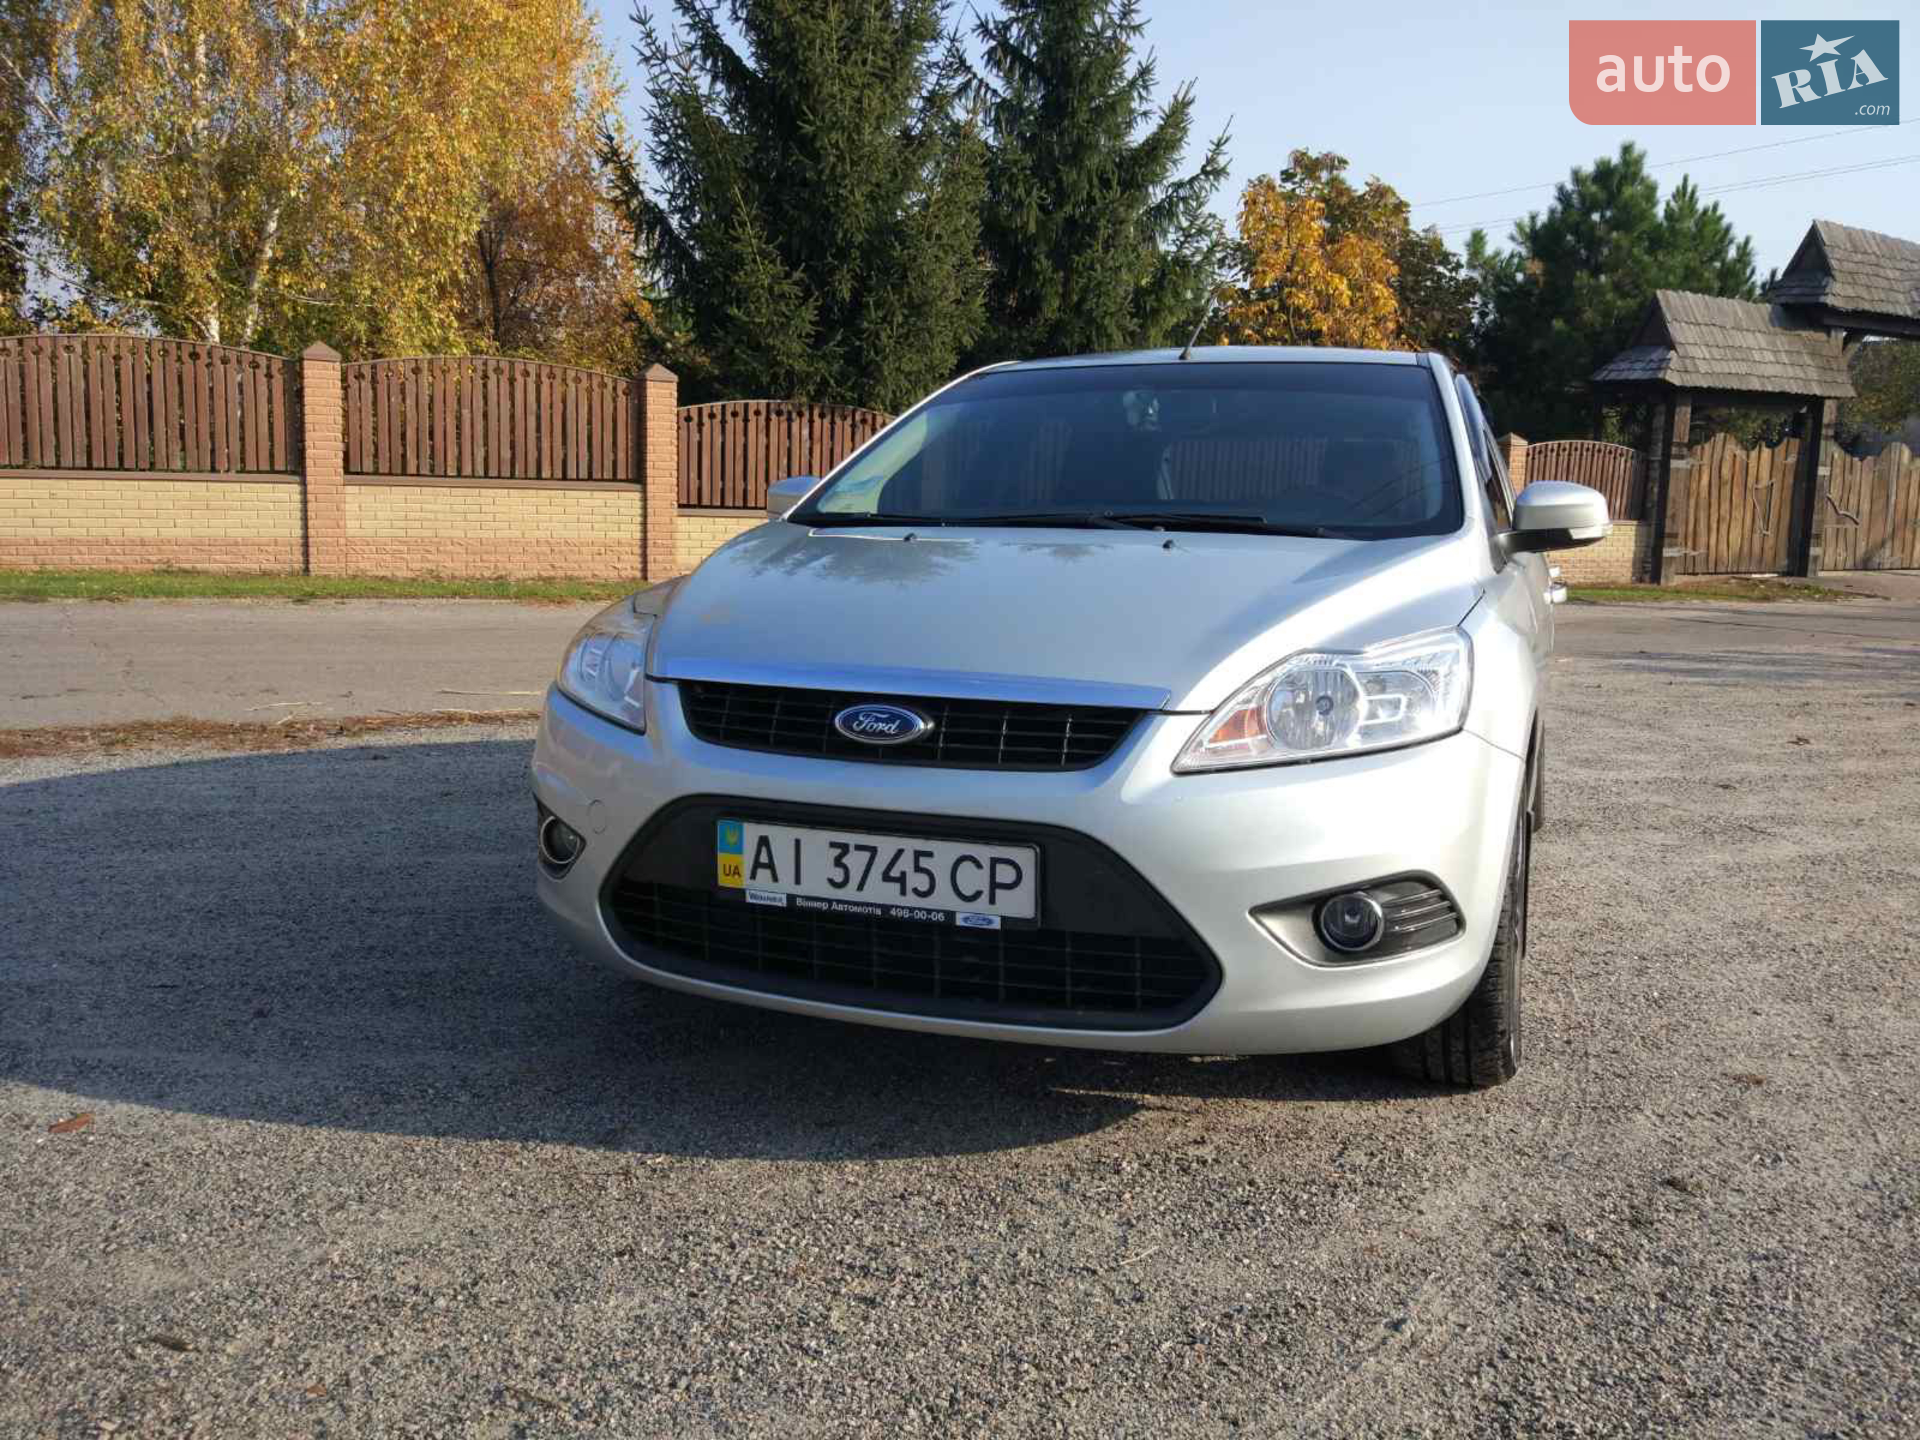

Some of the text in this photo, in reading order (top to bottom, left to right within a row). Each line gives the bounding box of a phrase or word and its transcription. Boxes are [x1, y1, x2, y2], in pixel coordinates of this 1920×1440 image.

[852, 712, 901, 734] Ford
[723, 864, 741, 878] UA
[750, 835, 1023, 905] AI 3745 CP
